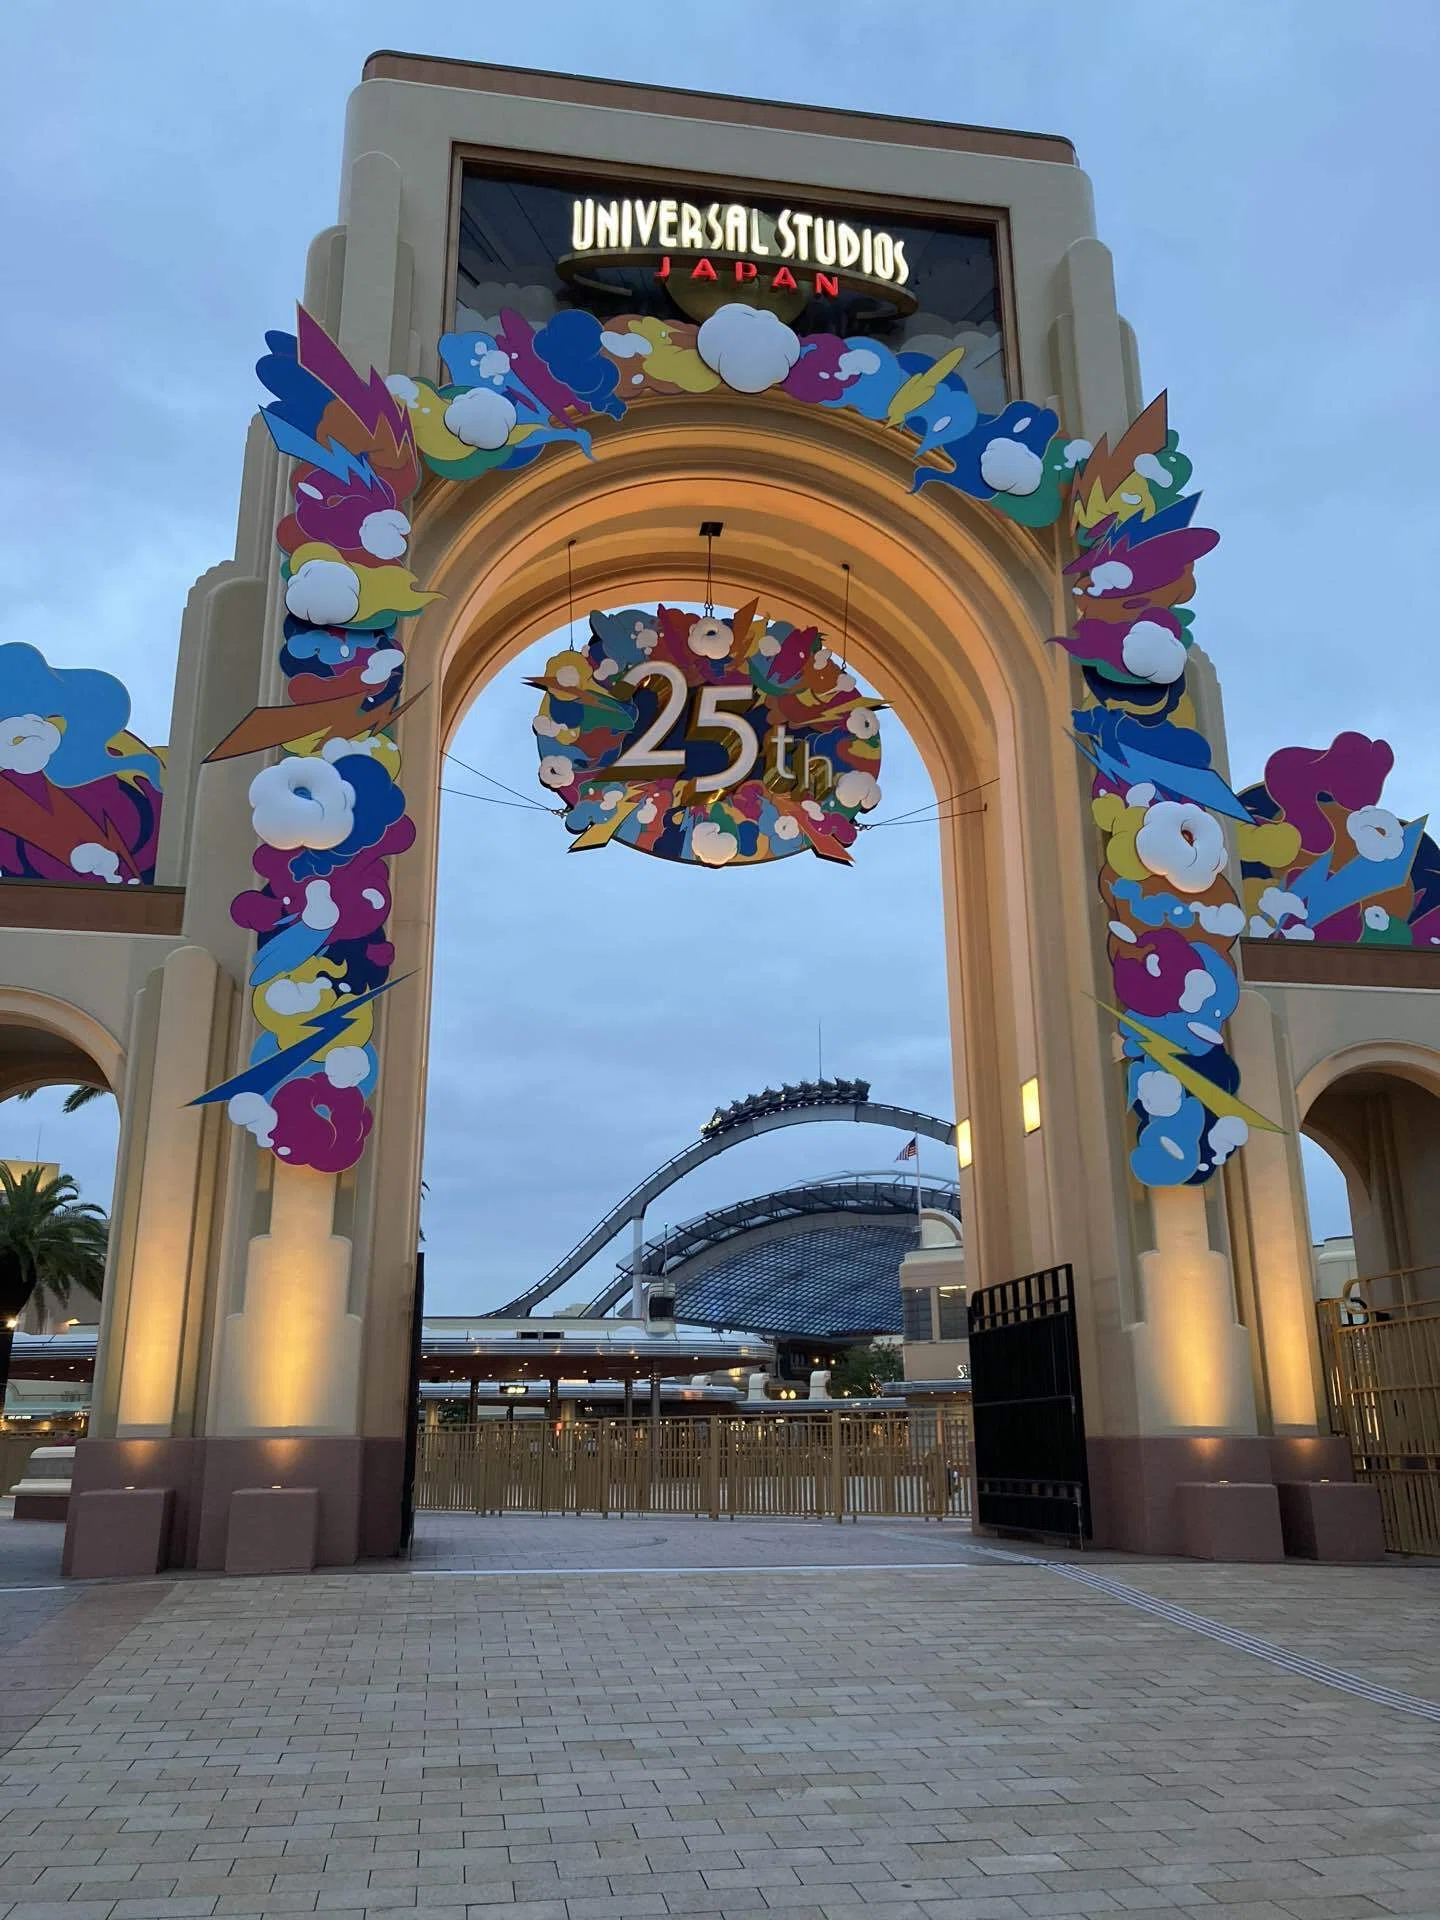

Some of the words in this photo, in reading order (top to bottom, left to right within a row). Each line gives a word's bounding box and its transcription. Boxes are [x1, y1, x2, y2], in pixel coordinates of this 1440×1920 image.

[572, 198, 768, 256] UNIVERSAL
[776, 208, 910, 286] STUDIOS
[655, 255, 840, 297] JAPAN
